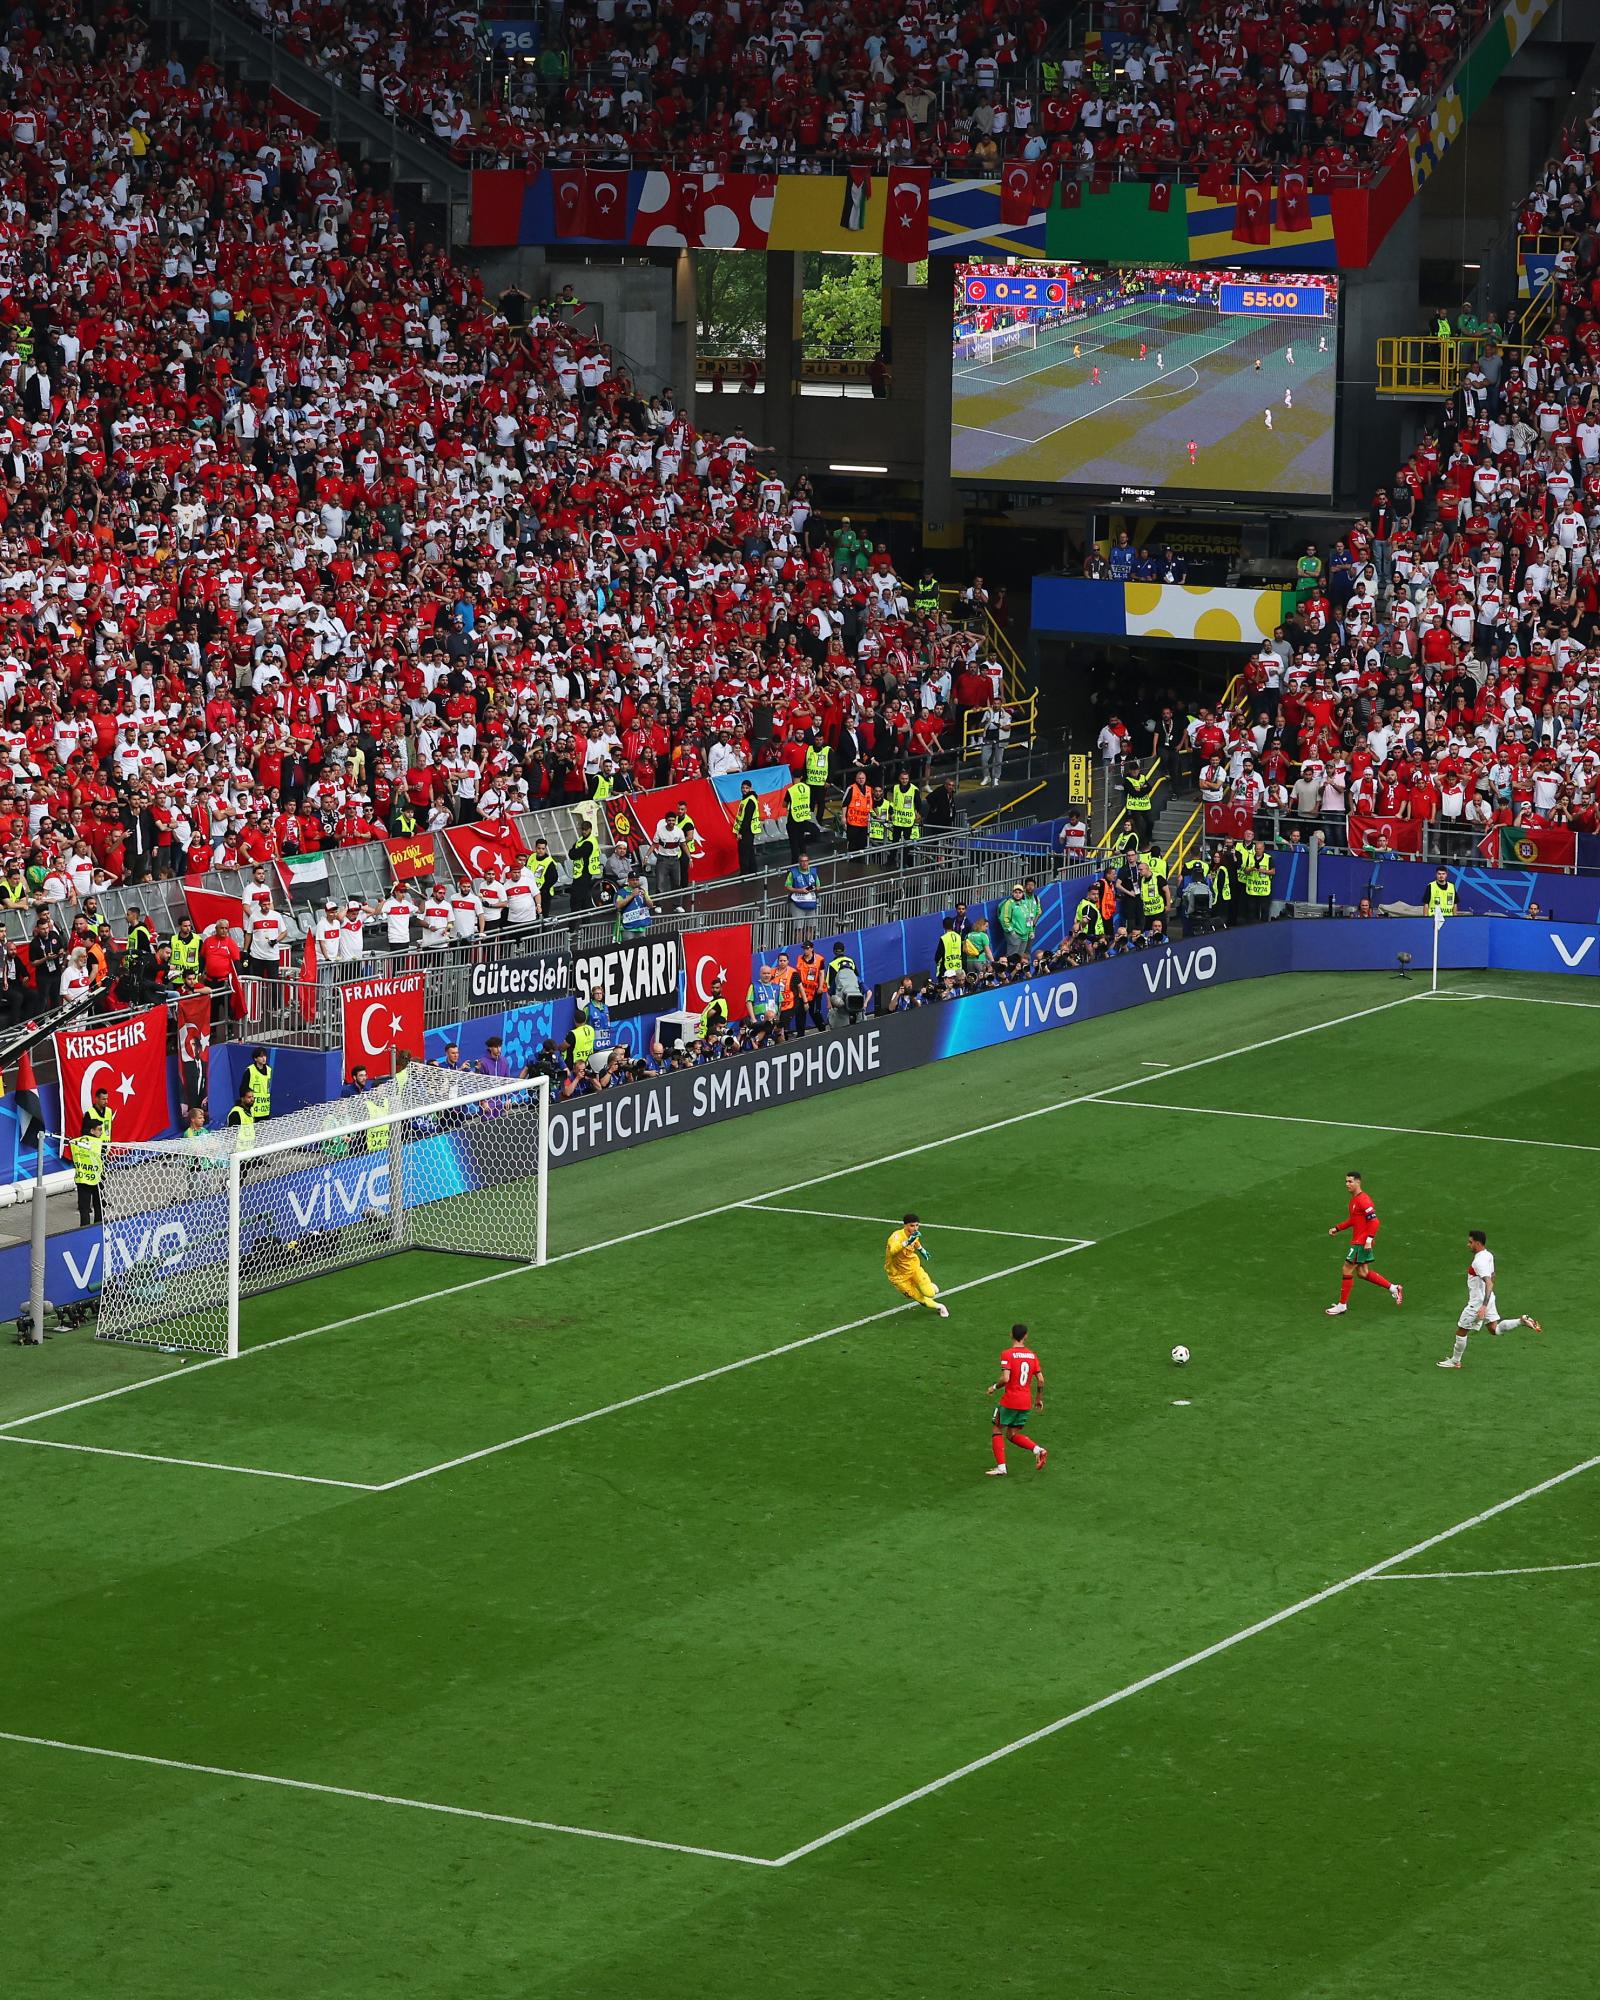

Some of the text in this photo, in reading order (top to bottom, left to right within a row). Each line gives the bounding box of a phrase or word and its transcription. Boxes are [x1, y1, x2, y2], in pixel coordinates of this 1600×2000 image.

[501, 31, 534, 49] 36
[1242, 291, 1298, 308] 55:00
[1121, 487, 1156, 496] Hisense
[1071, 755, 1082, 763] 23
[472, 957, 569, 996] Gütersloh
[574, 940, 678, 1011] SPEXARD
[1142, 945, 1218, 993] vivo
[345, 976, 421, 1003] FRANKFURT
[998, 982, 1079, 1032] vivo
[65, 1020, 148, 1061] KIRSEHIR
[549, 1029, 881, 1157] OFFICIAL SMARTPHONE
[286, 1164, 391, 1229] vivo
[62, 1220, 189, 1291] vivo
[1019, 1361, 1030, 1387] 8
